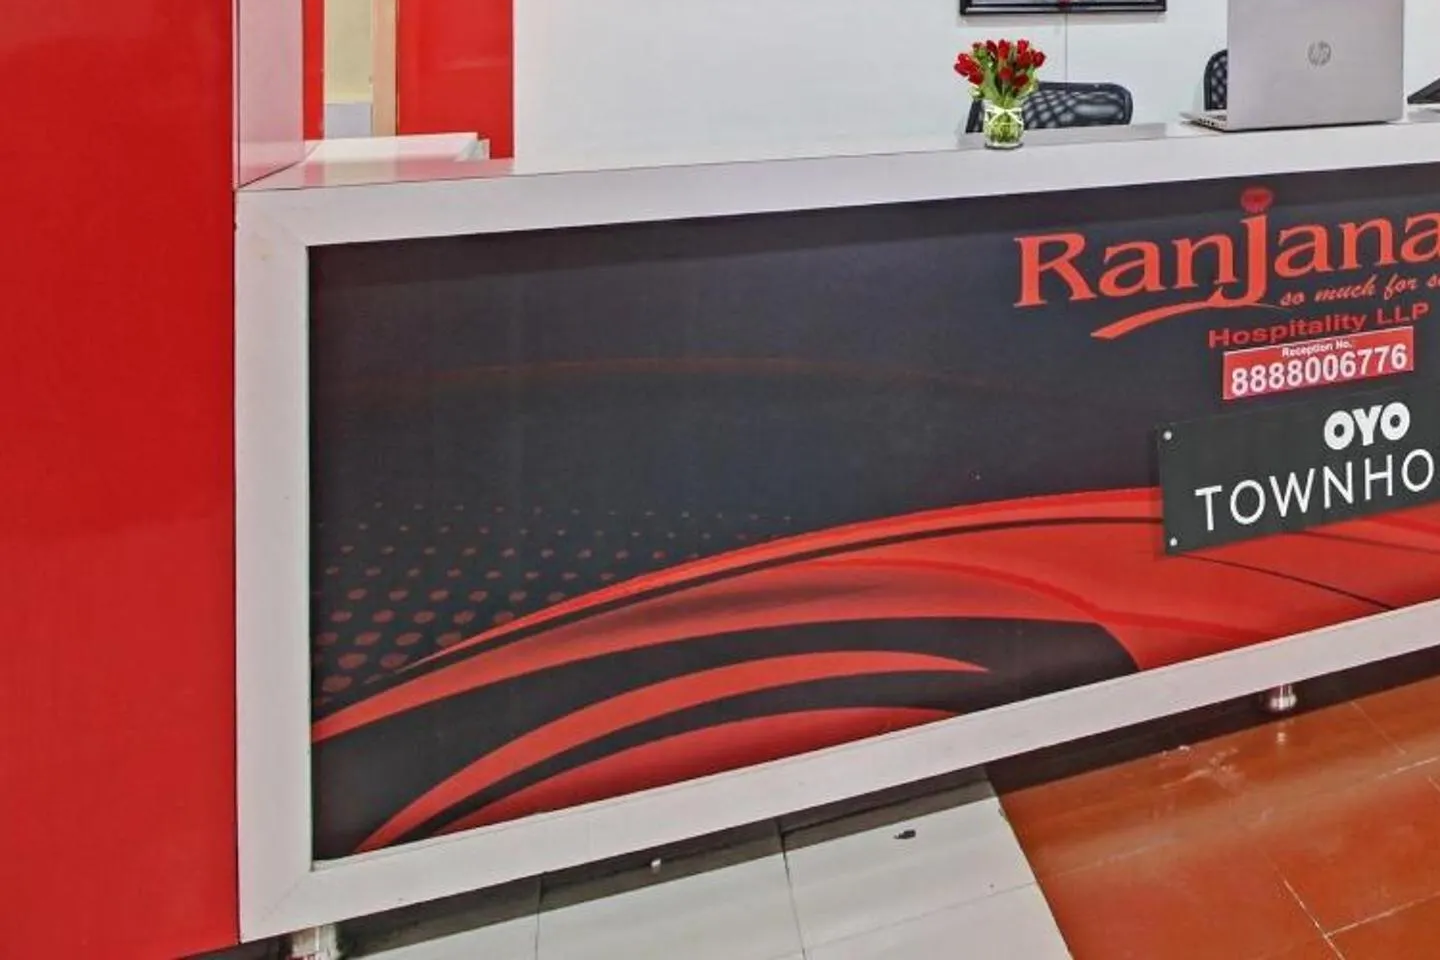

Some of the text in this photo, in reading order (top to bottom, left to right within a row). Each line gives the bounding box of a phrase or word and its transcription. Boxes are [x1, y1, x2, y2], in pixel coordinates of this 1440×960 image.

[1280, 291, 1305, 307] so
[1314, 273, 1377, 303] much
[1383, 273, 1418, 300] for
[1208, 302, 1430, 349] Hospitality LLP
[1231, 343, 1409, 397] 8888006776
[1323, 401, 1411, 451] OYO
